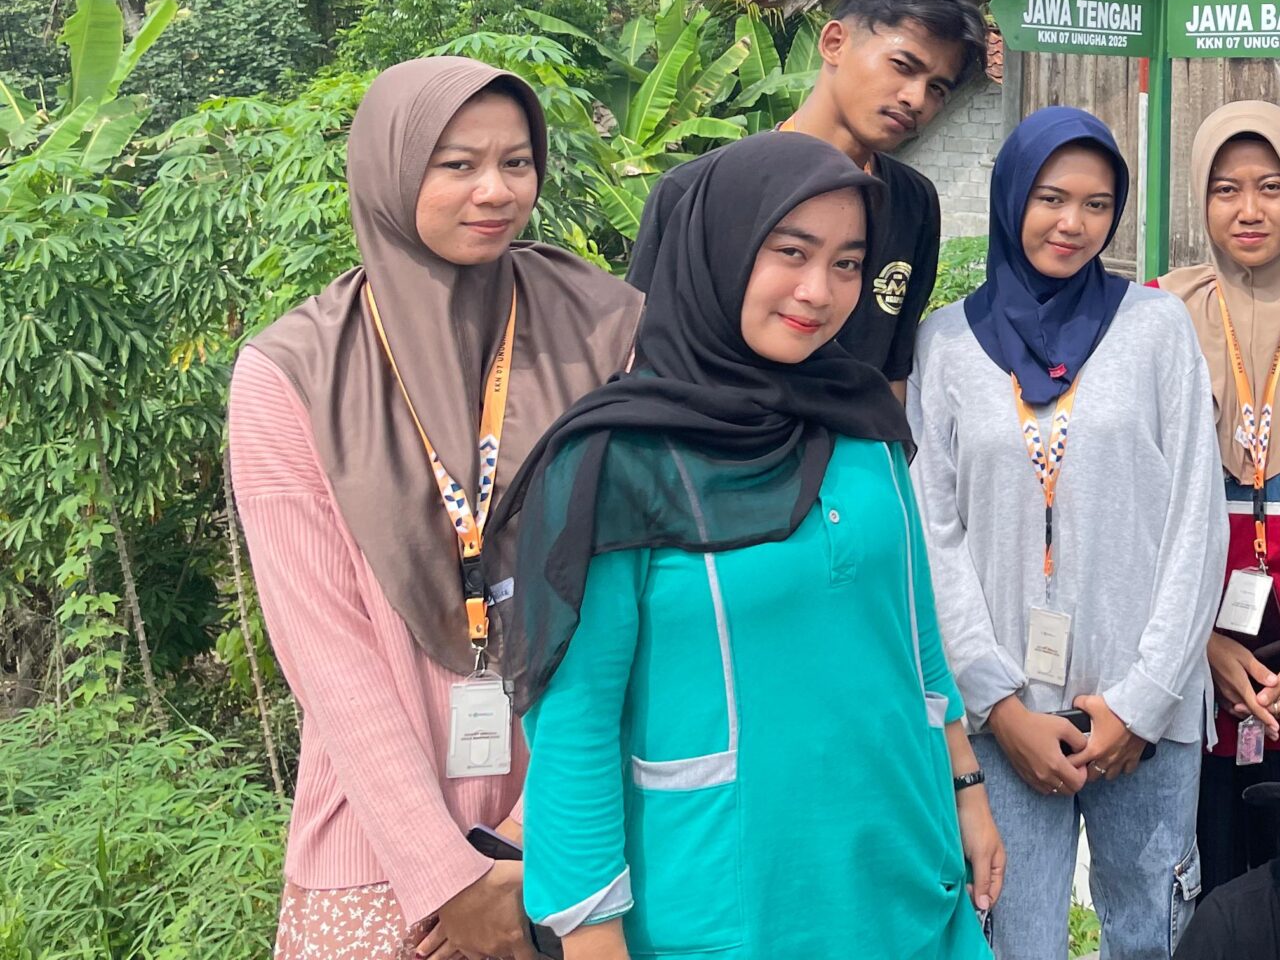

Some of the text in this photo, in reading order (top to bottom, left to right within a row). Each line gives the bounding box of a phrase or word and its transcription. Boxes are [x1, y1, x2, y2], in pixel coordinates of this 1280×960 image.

[1076, 0, 1142, 31] TENGAH
[1185, 4, 1250, 32] JAWA
[1037, 30, 1128, 48] KKN 07 UNUGHA 2025
[1196, 37, 1223, 49] KKN
[1226, 37, 1240, 49] 07
[494, 376, 502, 392] KKN
